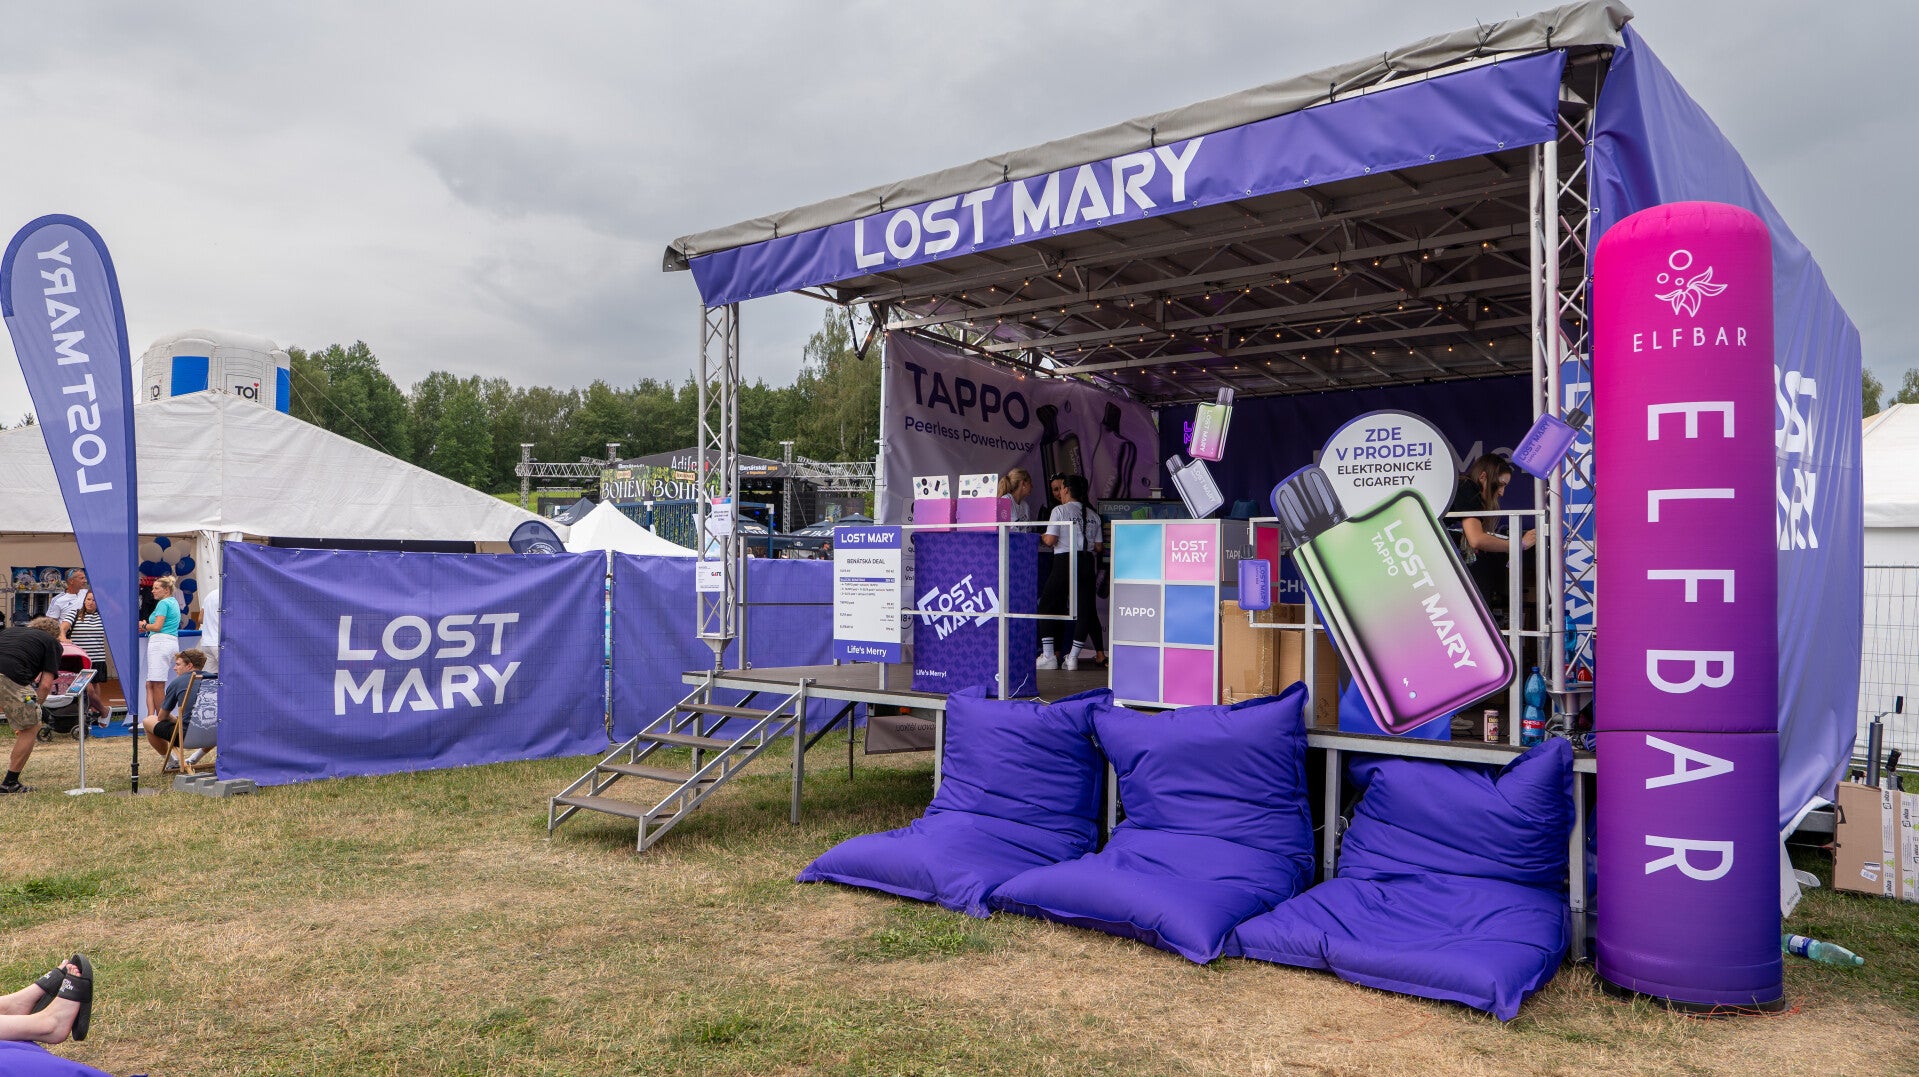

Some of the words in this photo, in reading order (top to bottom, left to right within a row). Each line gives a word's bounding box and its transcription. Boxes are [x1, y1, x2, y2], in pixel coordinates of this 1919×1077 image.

[854, 186, 997, 269] LOST
[1011, 137, 1205, 237] MARY
[1633, 326, 1748, 352] ELFBAR
[904, 361, 1030, 430] TAPPO
[1203, 409, 1213, 430] LOST
[904, 415, 960, 440] Peerless
[963, 428, 1035, 454] Powerhouse
[1199, 430, 1209, 453] MARY
[1365, 426, 1402, 443] ZDE
[1520, 438, 1538, 461] LOST
[1532, 420, 1550, 443] MARY
[1335, 447, 1349, 461] V
[1353, 442, 1433, 461] PRODEJI
[1337, 458, 1432, 475] ELEKTRONICKÉ
[602, 477, 645, 499] BOHÉM
[1192, 466, 1206, 485] LOST
[1202, 484, 1217, 504] MARY
[1353, 475, 1415, 488] CIGARETY
[1104, 504, 1131, 512] TAPPO
[841, 533, 866, 543] LOST
[867, 532, 895, 543] MARY
[1171, 540, 1209, 551] LOST
[1171, 551, 1209, 563] MARY
[1371, 531, 1399, 577] TAPPO
[928, 574, 974, 622] LOST
[1384, 519, 1435, 589] LOST
[1421, 592, 1478, 670] MARY
[934, 590, 986, 641] MARY
[1118, 606, 1156, 618] TAPPO
[336, 612, 521, 662] LOST
[1645, 400, 1736, 882] ELFBAR
[847, 645, 865, 655] Life's
[866, 646, 887, 657] Merry
[915, 668, 929, 676] Life's
[333, 661, 521, 716] MARY
